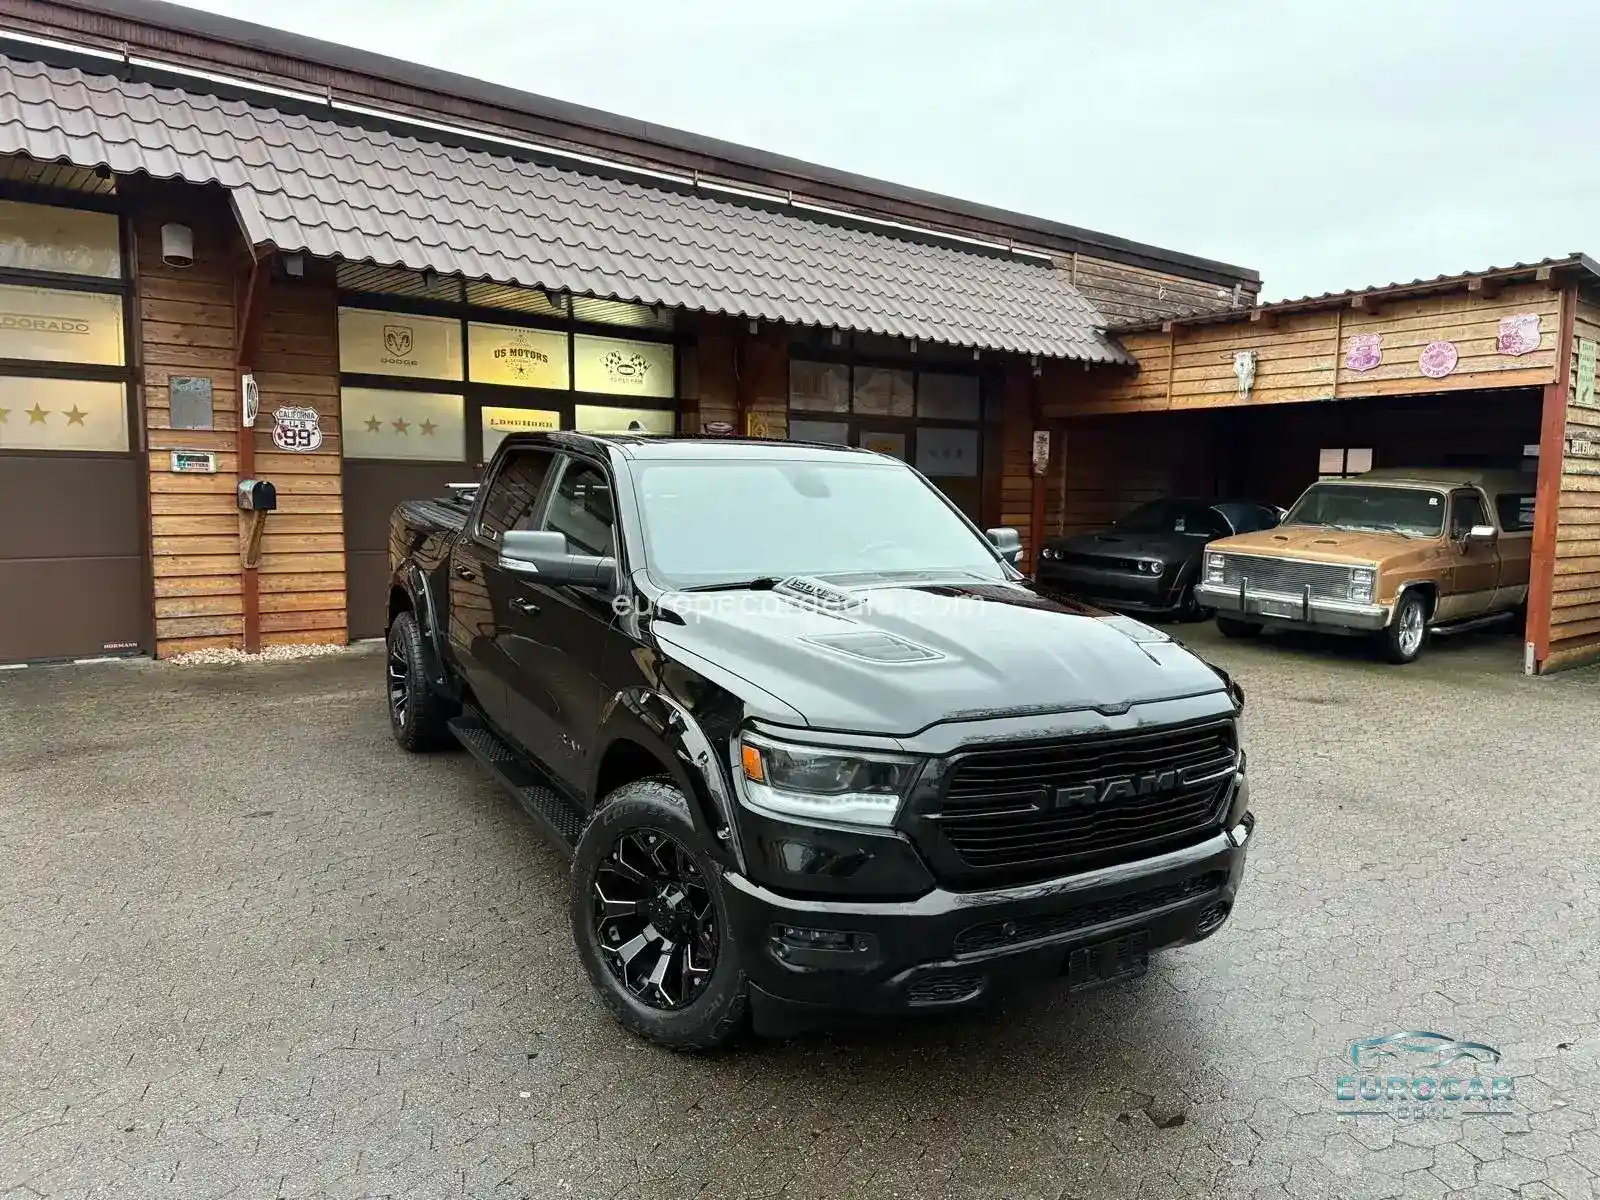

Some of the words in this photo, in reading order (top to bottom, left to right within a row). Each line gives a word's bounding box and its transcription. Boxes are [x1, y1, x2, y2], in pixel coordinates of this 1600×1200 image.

[0, 316, 89, 332] DORADO
[380, 358, 418, 366] DODGE
[494, 349, 506, 358] US
[510, 348, 548, 363] MOTORS
[278, 410, 315, 419] CALIFORNIA
[284, 429, 310, 446] 99
[1055, 771, 1176, 808] RAM
